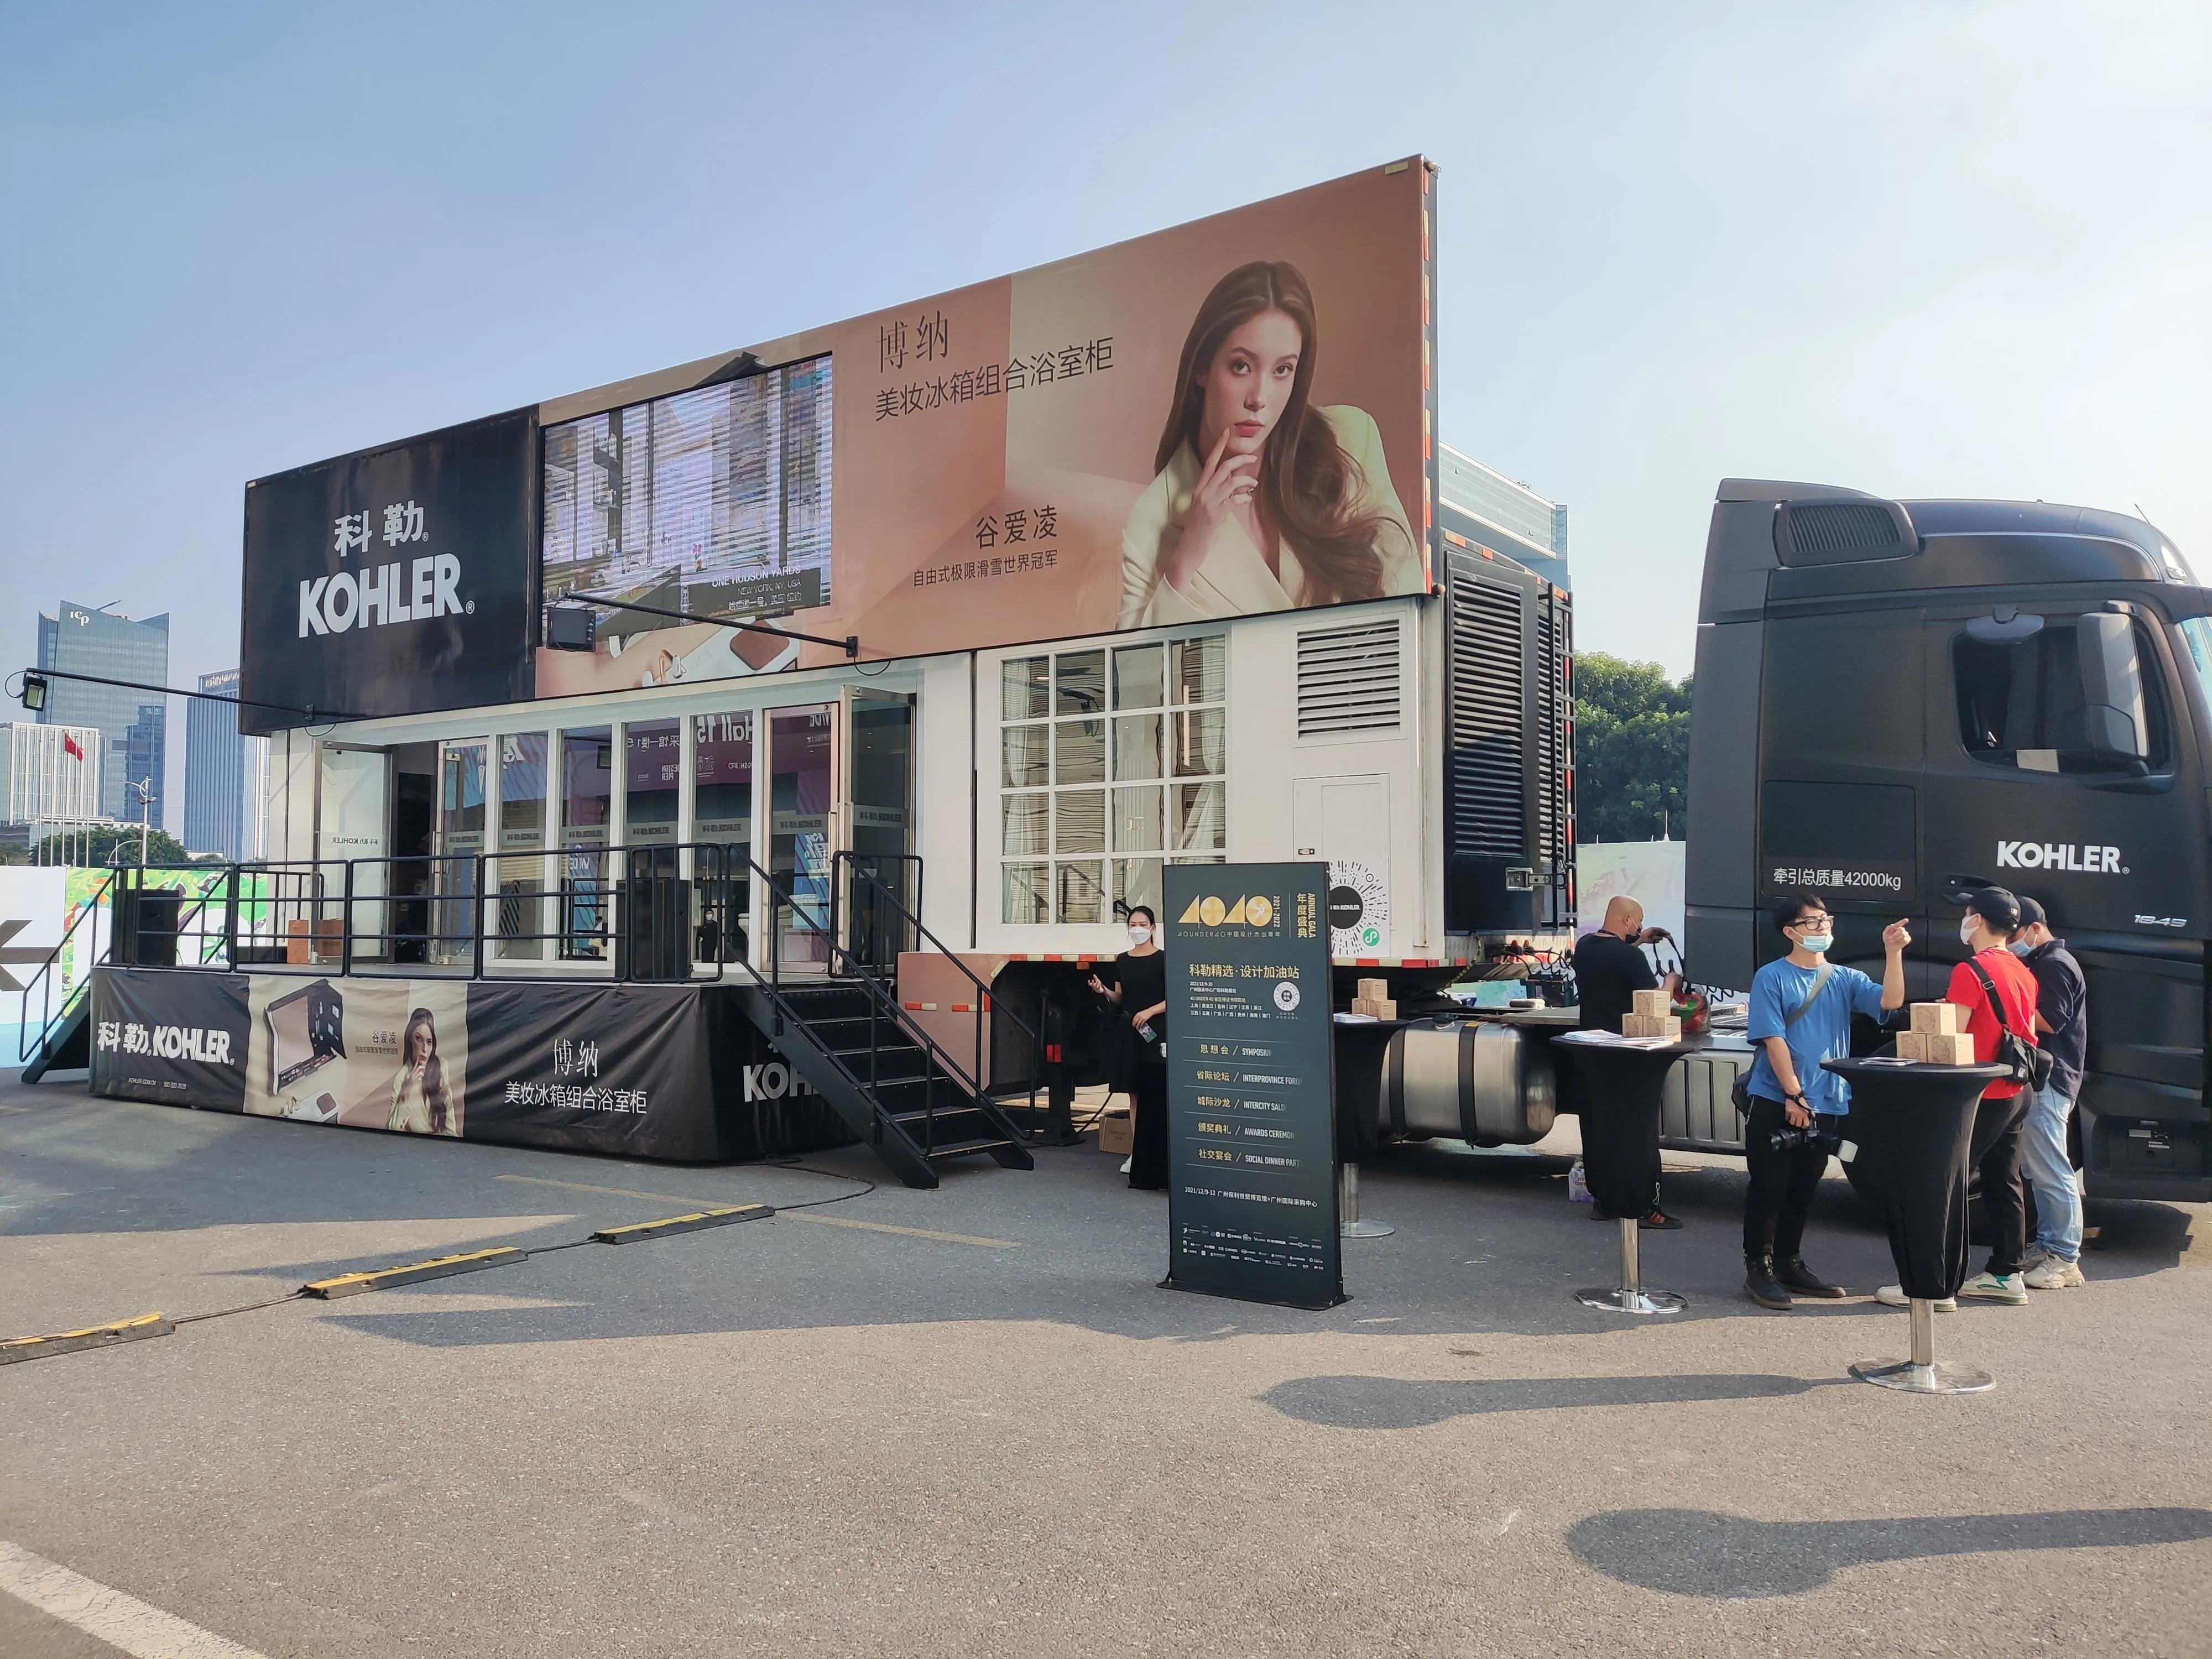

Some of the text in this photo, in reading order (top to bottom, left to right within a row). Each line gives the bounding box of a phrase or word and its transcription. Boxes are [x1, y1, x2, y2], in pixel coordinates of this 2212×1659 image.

[875, 310, 949, 373] 博纳
[875, 336, 1114, 422] 美妆冰箱组合浴室柜
[334, 500, 425, 557] 科勒
[975, 504, 1057, 549] 谷爱凌
[712, 565, 801, 587] ONE HUDSON YARDS
[914, 549, 1058, 587] 自由式极限滑雪世界冠军
[299, 553, 464, 638] KOHLER
[1997, 841, 2120, 874] KOHLER
[1773, 867, 1901, 891] 牵引总质量42000kg
[1297, 893, 1307, 938] 年度盛典
[1307, 893, 1317, 938] ANNUAL GALA
[2134, 915, 2188, 928] 1845
[1189, 963, 1300, 979] 科勒精选·设计加油站
[97, 1020, 231, 1065] 科勒 KOHLER
[372, 1030, 397, 1044] 谷爱凌
[1200, 1044, 1229, 1055] 思想会
[552, 1037, 599, 1078] 博纳
[1197, 1070, 1230, 1082] 省际论坛
[1243, 1074, 1285, 1085] INTERPROVINCE
[504, 1080, 648, 1114] 美妆冰箱组合浴室柜
[1197, 1095, 1287, 1111] 城际沙龙 INTERCITY SALO
[1198, 1122, 1232, 1134] 颁奖典礼
[1244, 1128, 1268, 1138] AWARDS
[1198, 1148, 1232, 1161] 社交宴会
[1245, 1154, 1264, 1164] SOCIAL
[1265, 1156, 1285, 1166] DINNER
[1185, 1186, 1216, 1196] 2021/12/9-12
